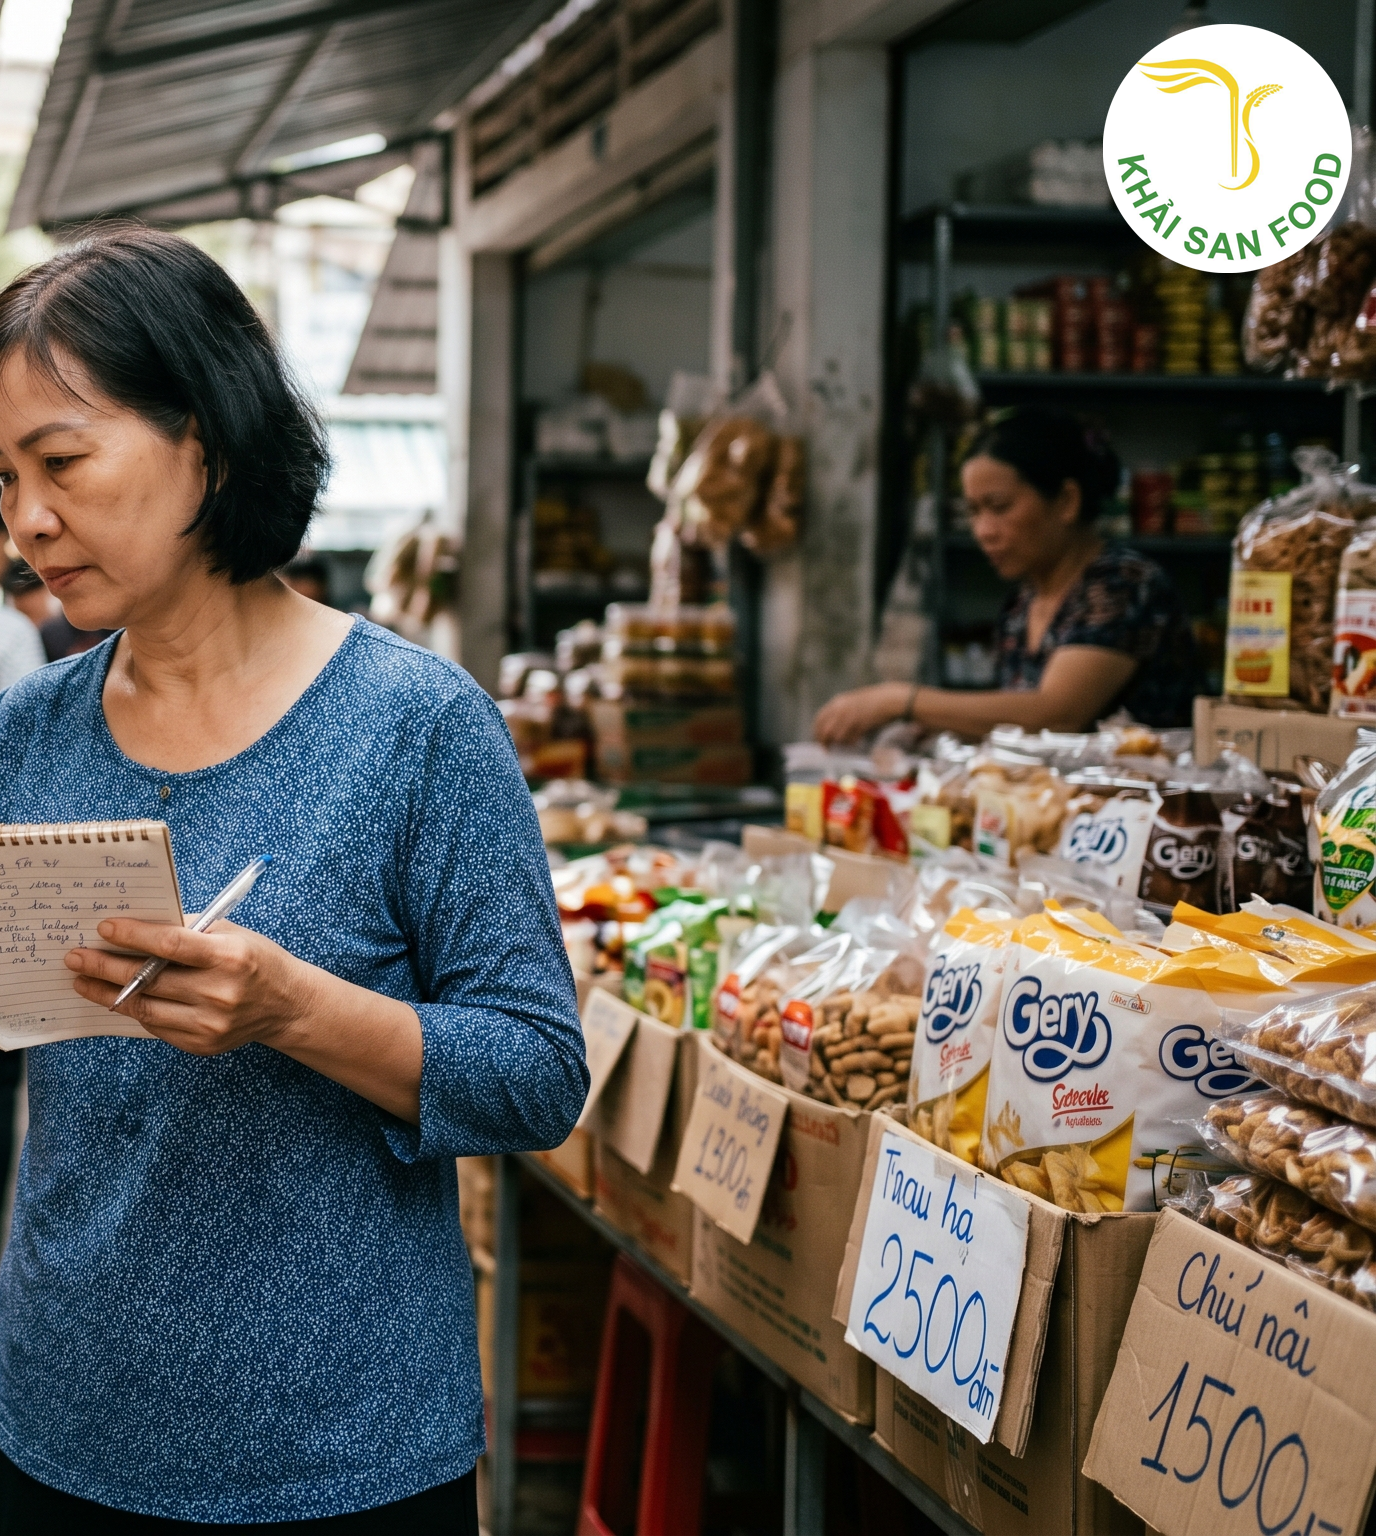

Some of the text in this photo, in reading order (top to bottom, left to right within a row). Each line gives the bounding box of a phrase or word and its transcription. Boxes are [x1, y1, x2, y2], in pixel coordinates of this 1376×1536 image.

[1153, 836, 1216, 880] Gery
[923, 954, 983, 1044] Gery
[1003, 976, 1112, 1082] Gery
[863, 1233, 987, 1386] 2500
[1140, 1361, 1310, 1536] 1500
